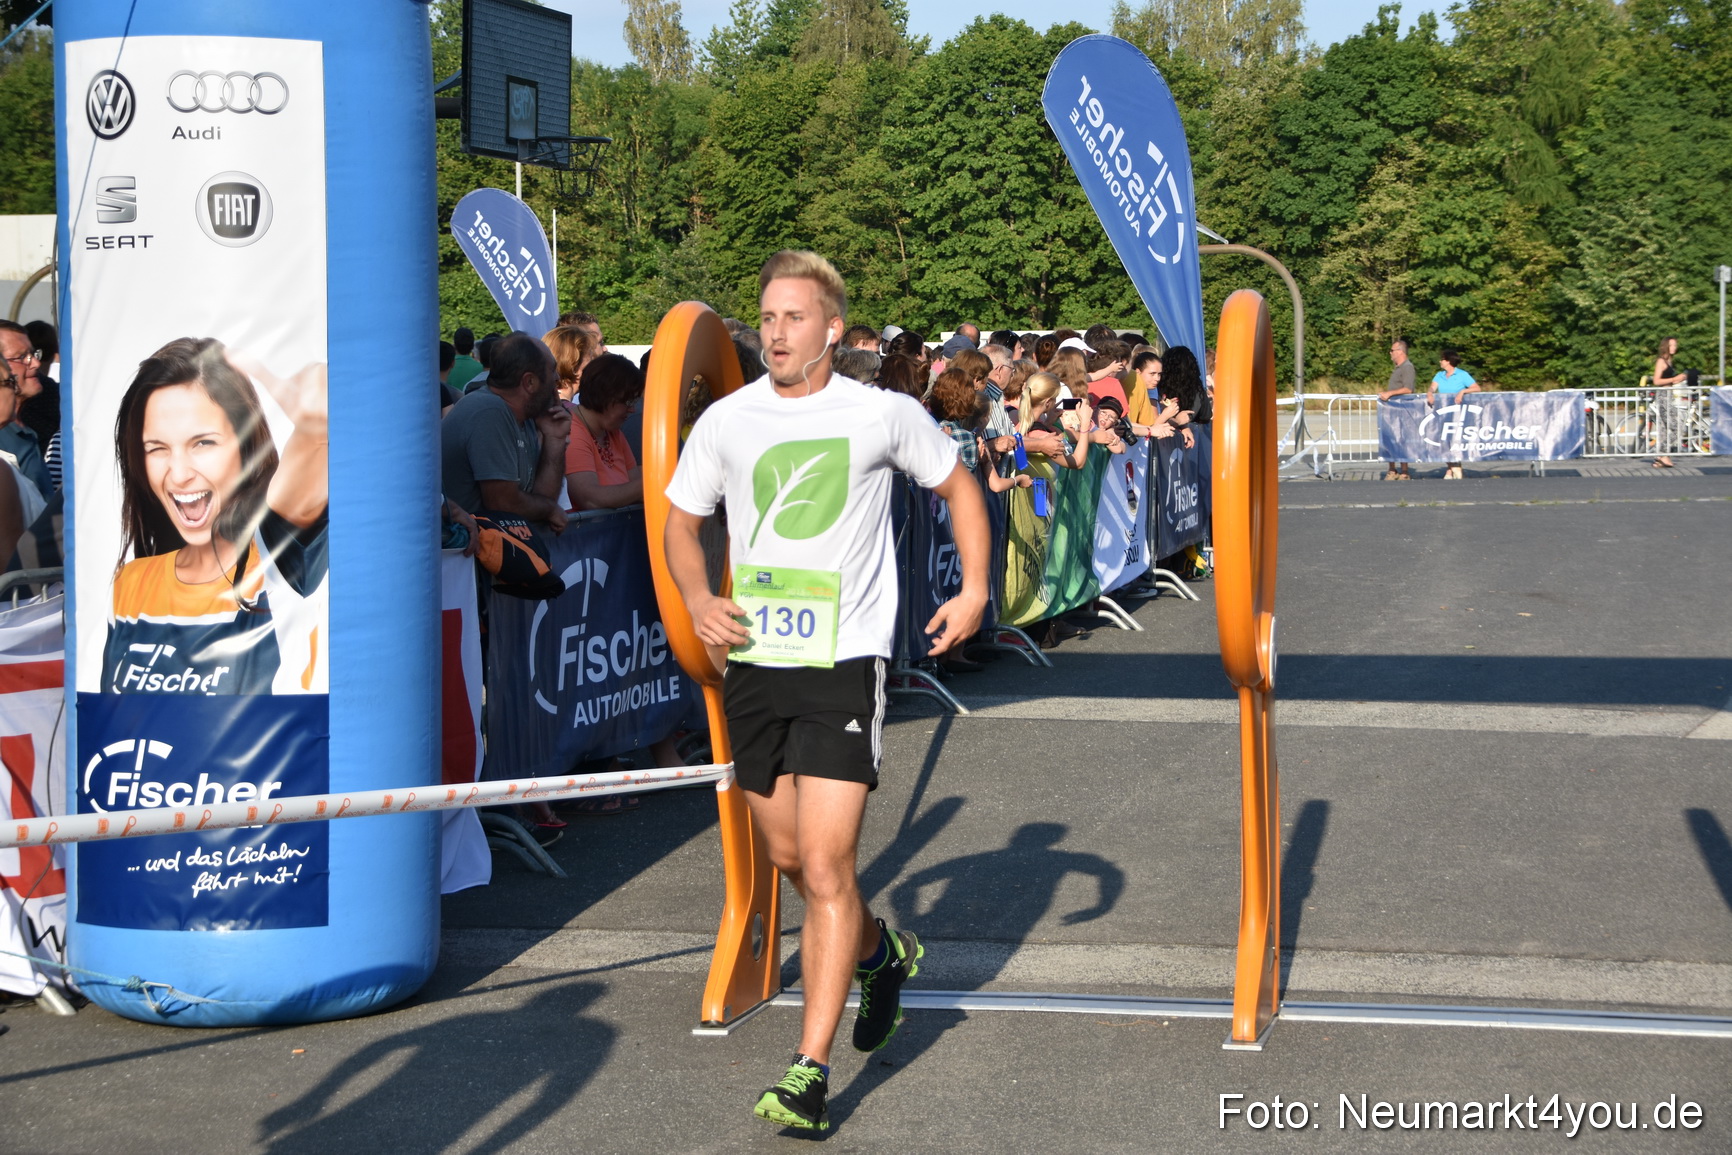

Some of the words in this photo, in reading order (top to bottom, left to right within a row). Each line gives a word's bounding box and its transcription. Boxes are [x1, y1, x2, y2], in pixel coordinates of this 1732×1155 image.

[171, 126, 221, 140] Audi
[213, 193, 256, 226] FIAT
[85, 235, 154, 250] SEAT
[1440, 421, 1542, 441] Fischer
[1450, 441, 1533, 451] AUTOMOBILE
[755, 605, 816, 638] 130
[558, 608, 676, 691] Fische
[122, 664, 230, 692] Fischer
[573, 675, 681, 728] AUTOMOBILE
[107, 772, 282, 807] Fischer
[185, 846, 223, 866] das
[191, 871, 249, 899] fährt
[253, 863, 303, 884] mit!
